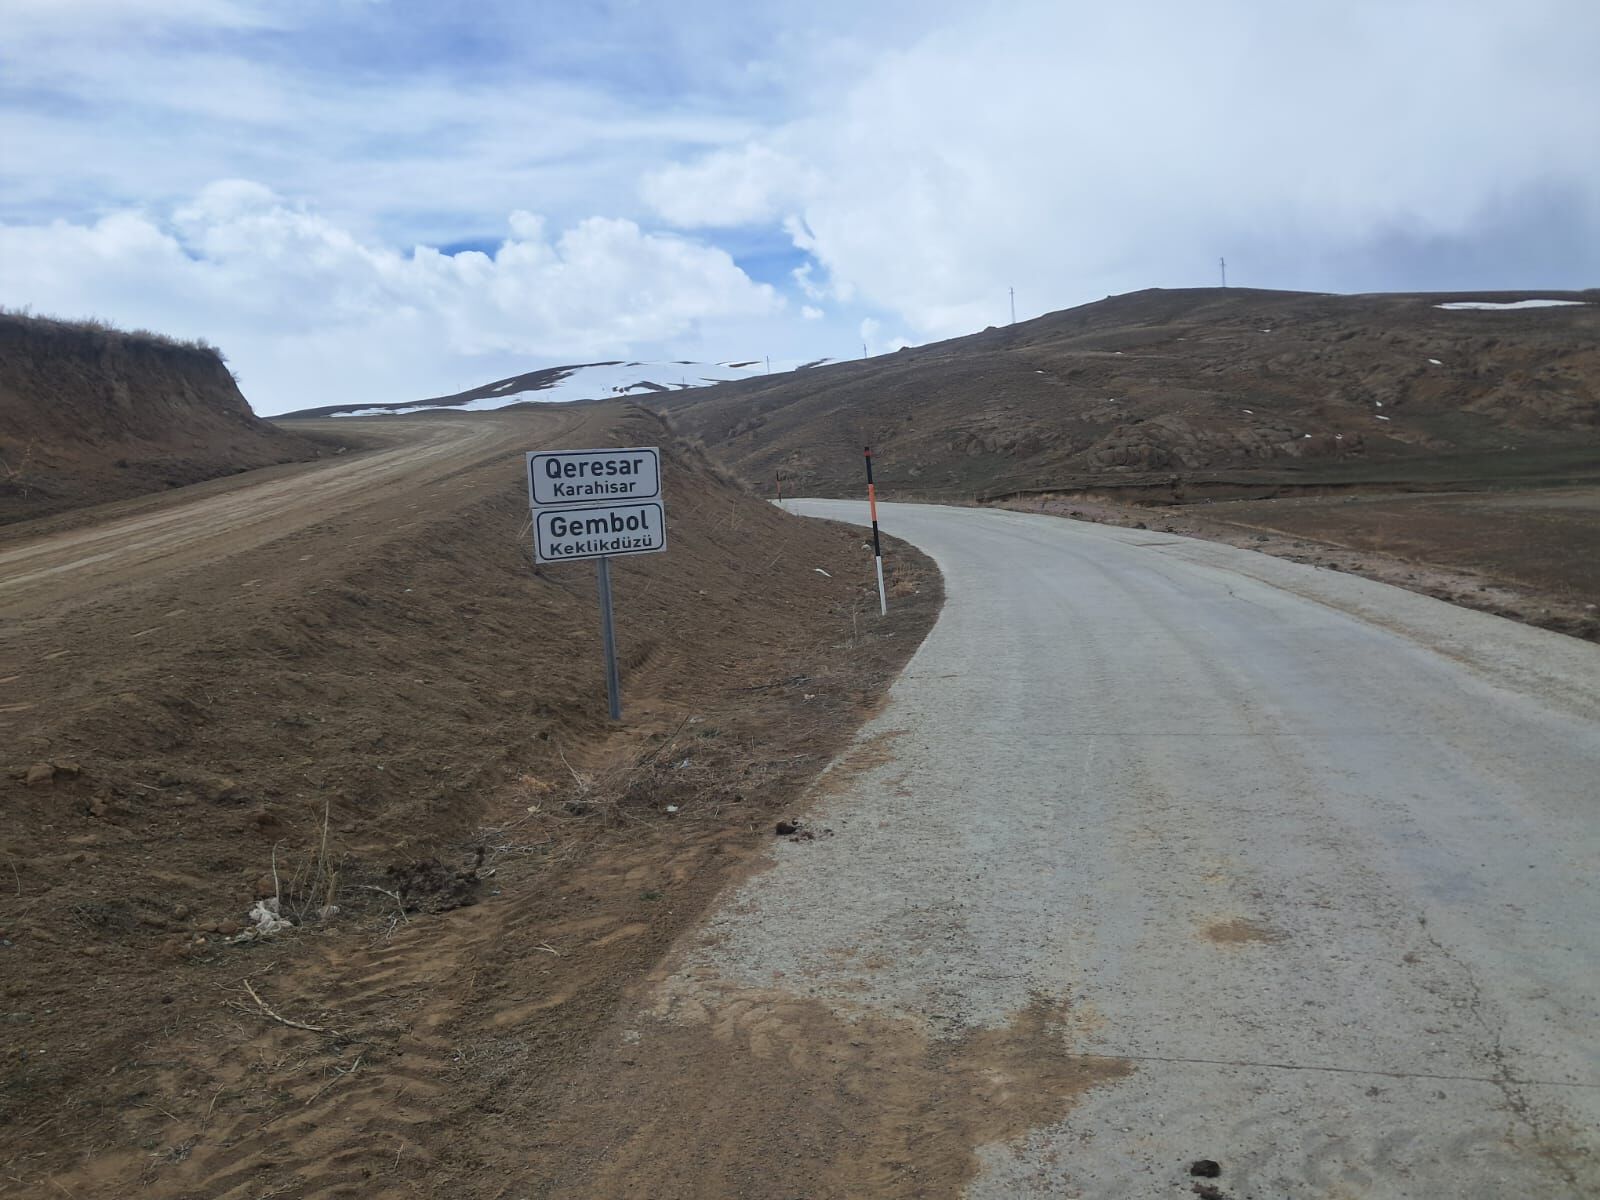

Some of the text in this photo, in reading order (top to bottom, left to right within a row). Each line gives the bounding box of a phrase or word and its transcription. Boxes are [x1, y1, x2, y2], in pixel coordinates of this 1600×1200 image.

[545, 458, 643, 479] Qeresar
[553, 481, 636, 497] Karahisar
[550, 510, 649, 537] Gembol
[550, 535, 652, 556] Keklikdüzü
